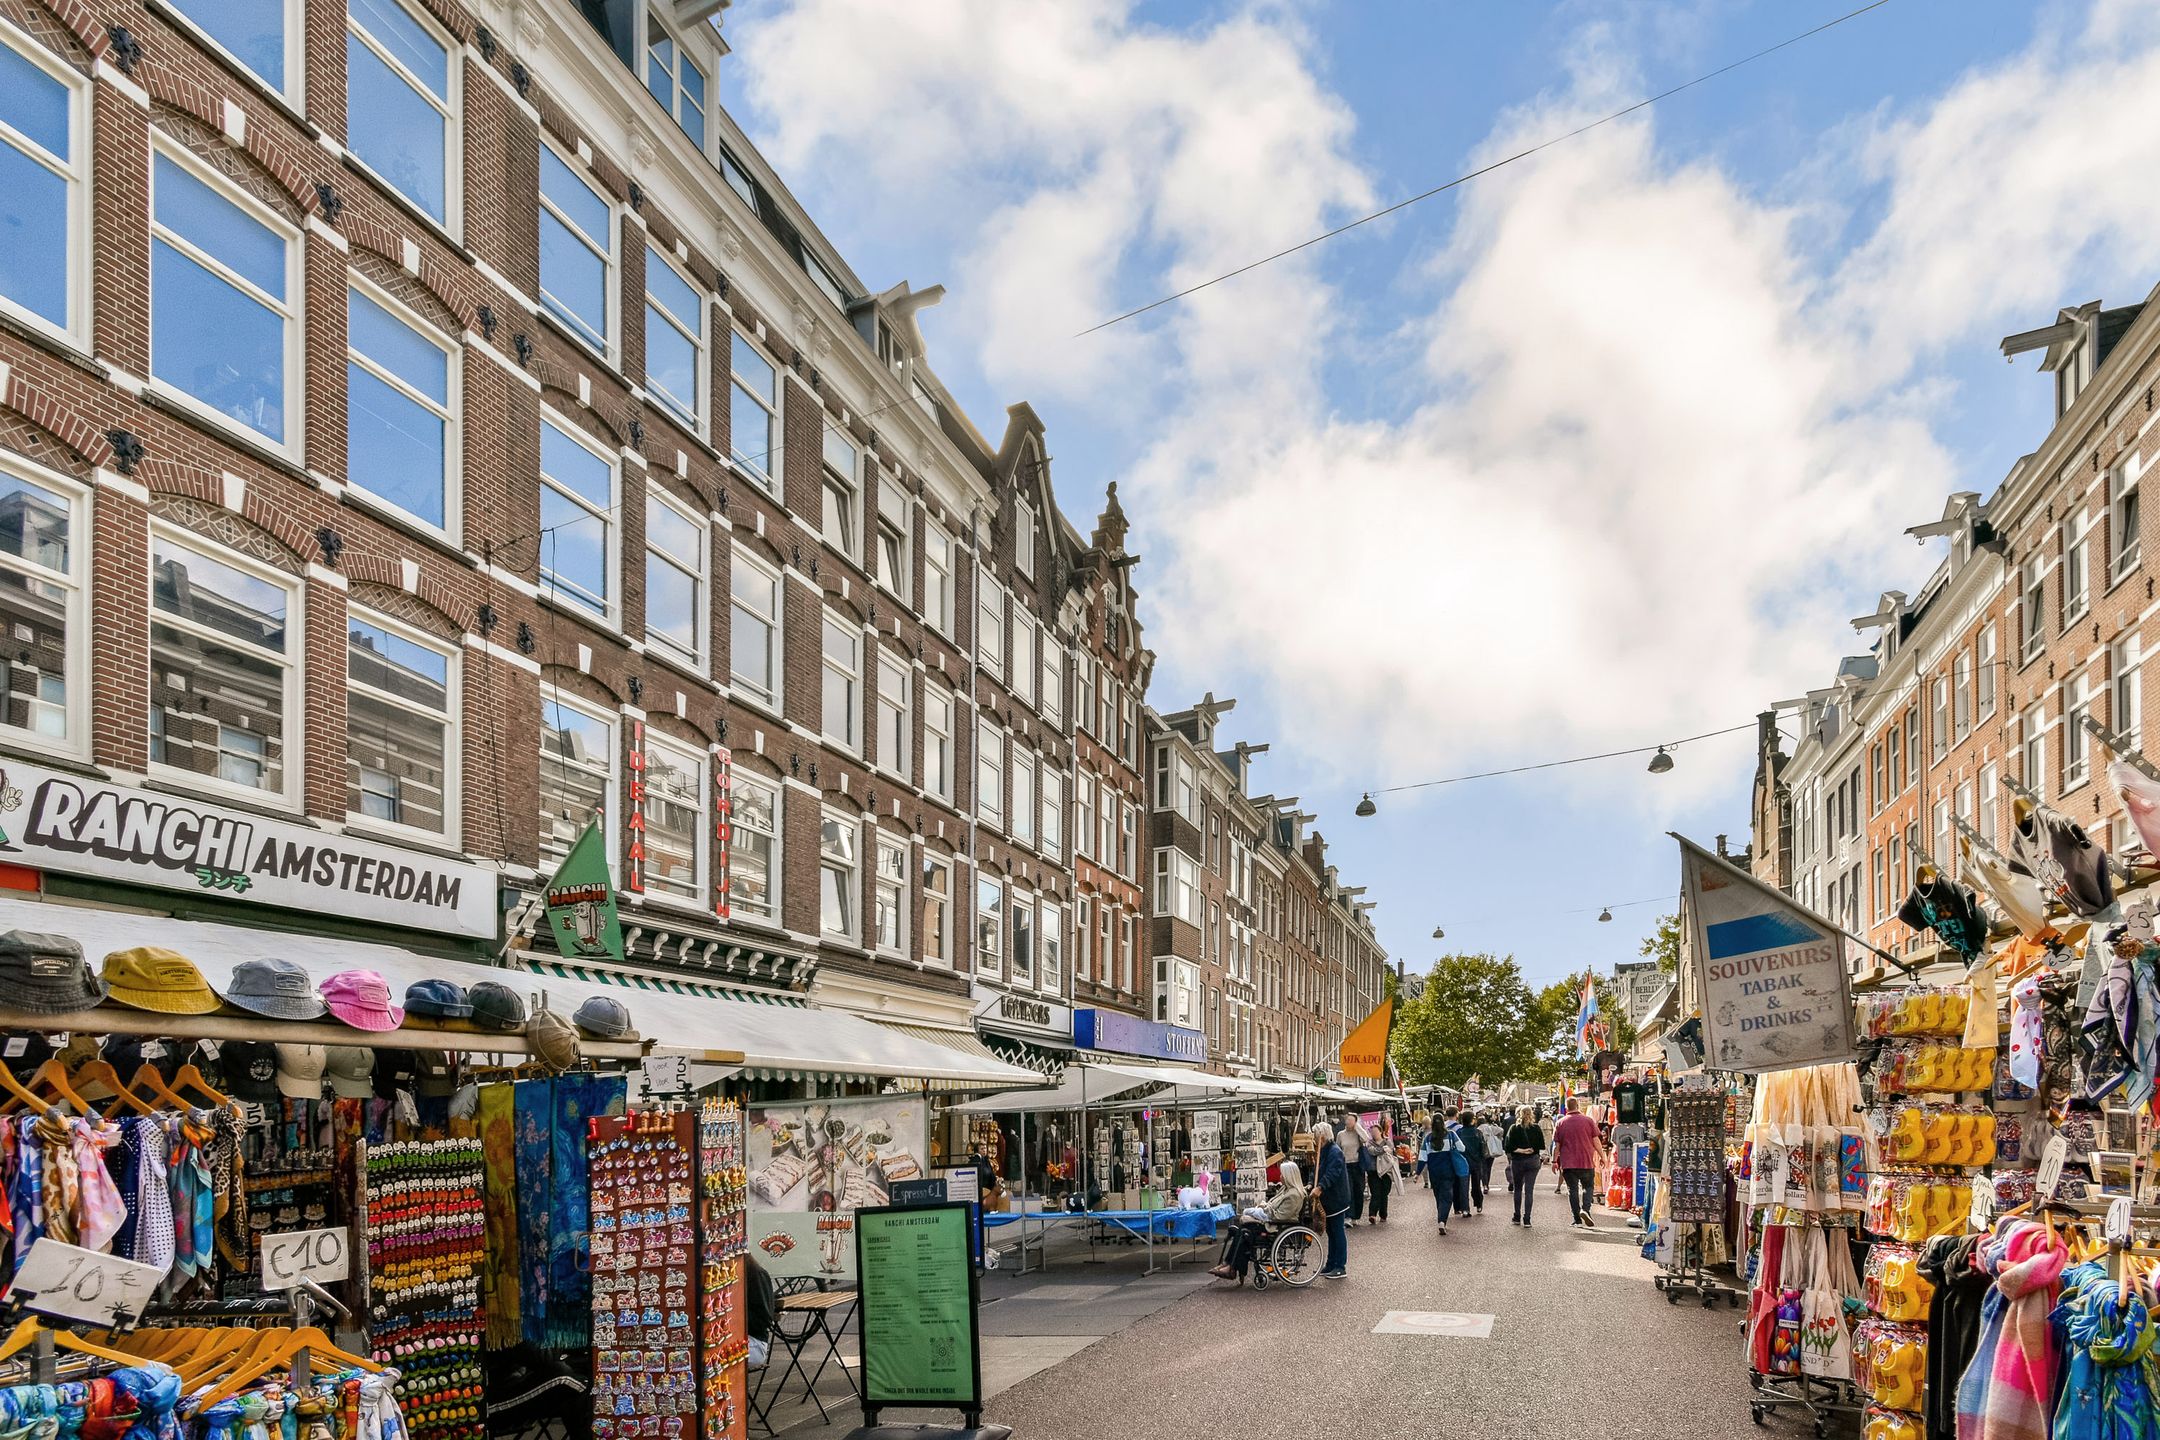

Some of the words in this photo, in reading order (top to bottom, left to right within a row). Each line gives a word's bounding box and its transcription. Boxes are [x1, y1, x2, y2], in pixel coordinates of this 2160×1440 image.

[24, 778, 253, 874] RANCHI
[252, 837, 463, 910] AMSTERDAM
[716, 749, 731, 918] GORDIJN
[194, 866, 253, 895] ランチ
[547, 883, 607, 907] RANCHI
[1709, 944, 1832, 982] SOUVENIRS
[1642, 973, 1670, 985] DEPOT
[1740, 973, 1804, 996] TABAK
[1766, 996, 1782, 1009] &
[1740, 1009, 1813, 1032] DRINKS
[1343, 1055, 1381, 1064] MIKADO
[928, 1183, 942, 1198] €1
[884, 1218, 904, 1227] RANCHI
[905, 1216, 940, 1226] AMSTERDAM
[268, 1231, 342, 1279] €10
